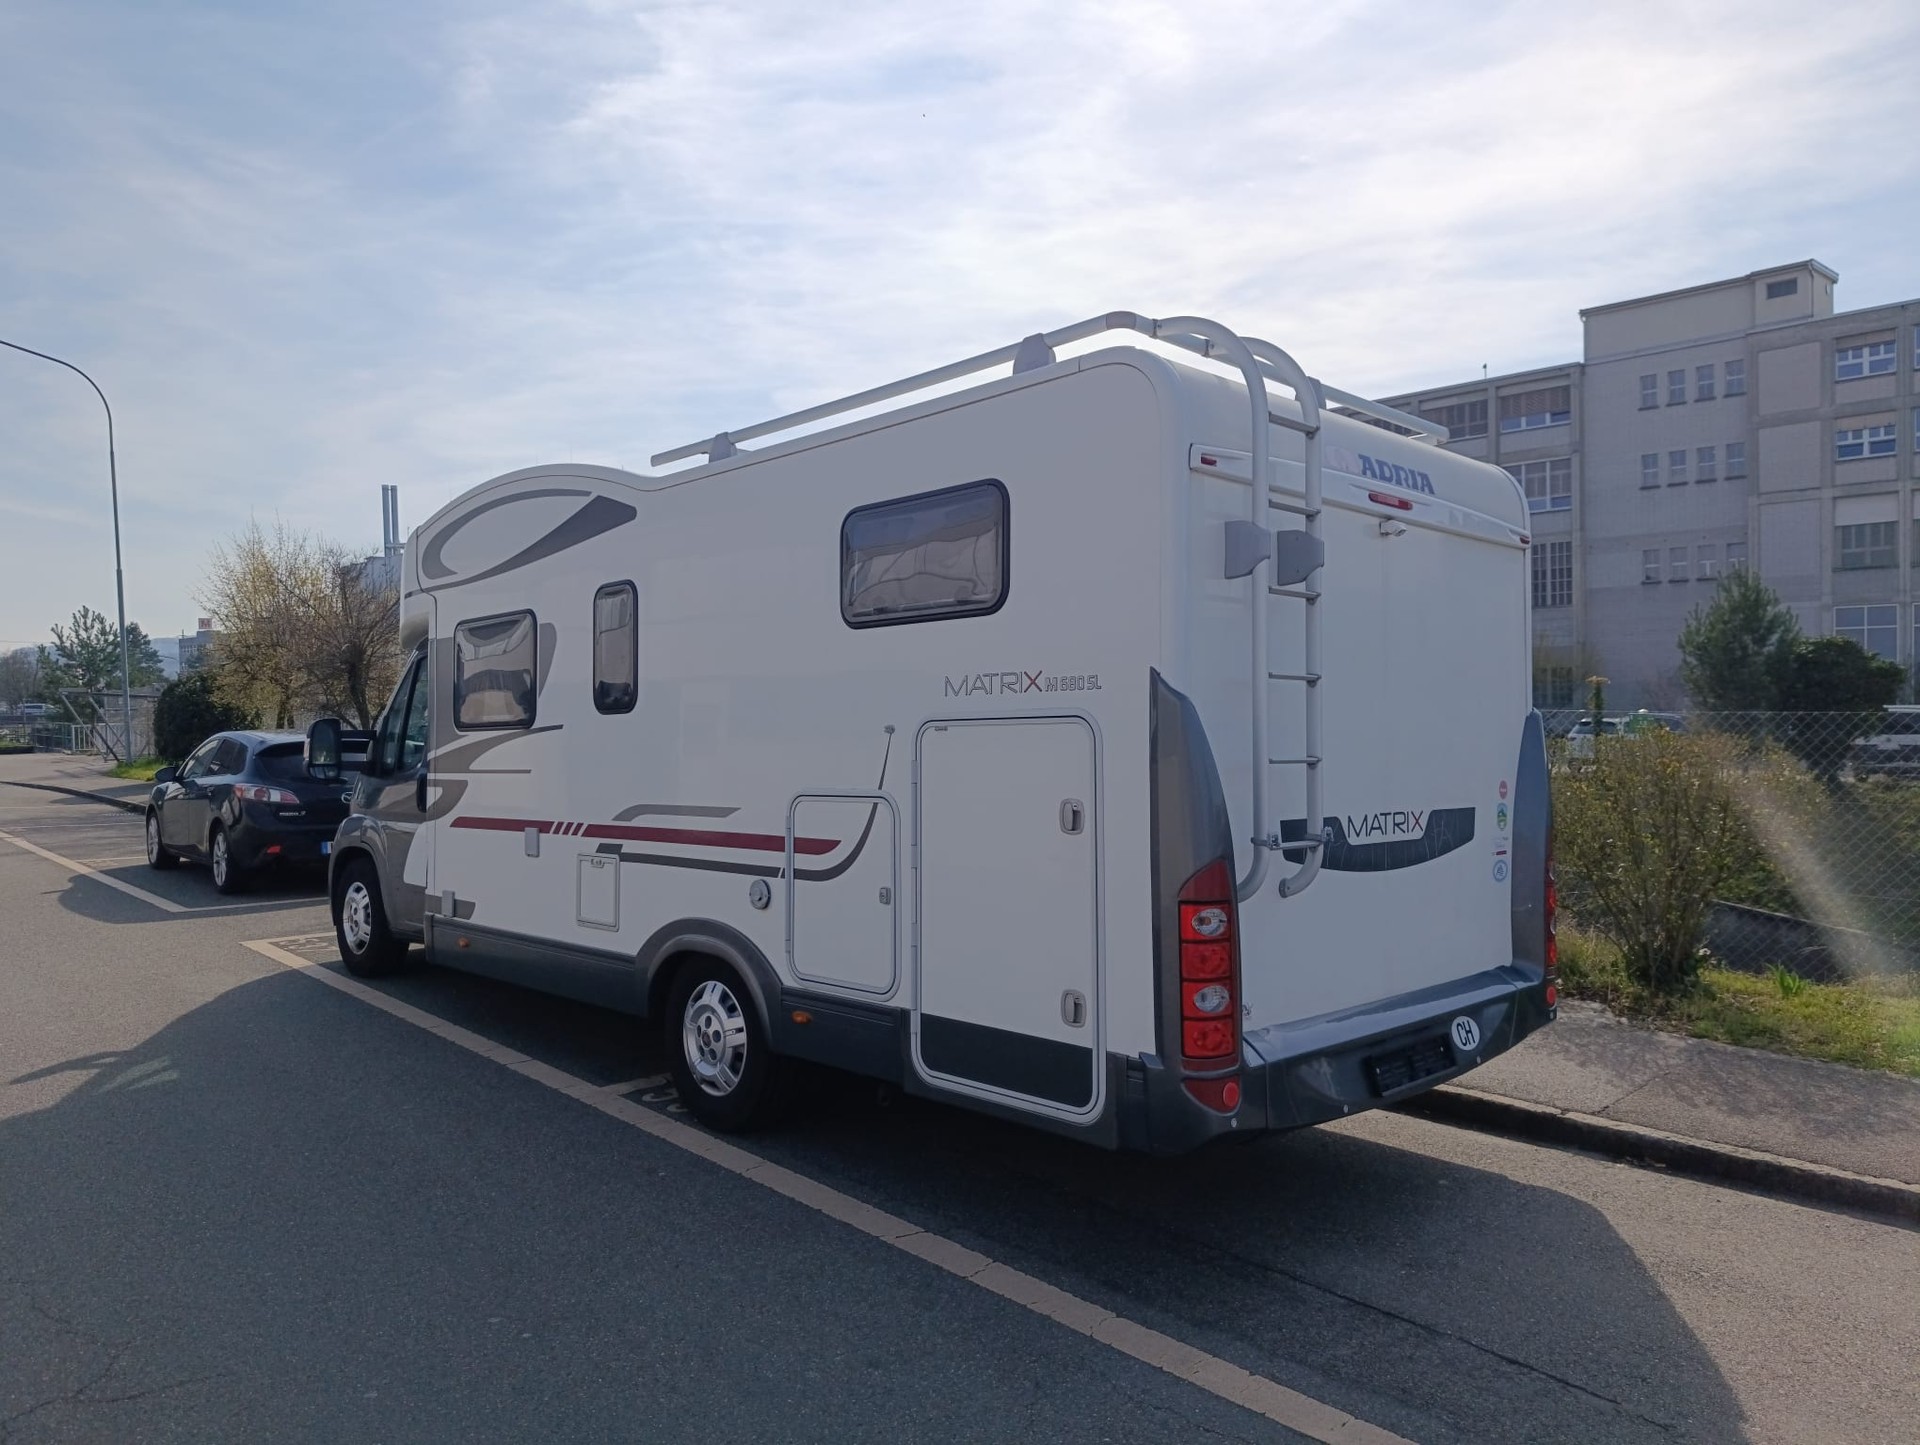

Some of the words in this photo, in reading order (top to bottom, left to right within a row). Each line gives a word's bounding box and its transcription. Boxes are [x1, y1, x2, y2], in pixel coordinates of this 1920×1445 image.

[1358, 453, 1435, 495] ADRIA
[944, 670, 1043, 697] MATRIX
[1347, 810, 1424, 839] MATRIX
[1456, 1019, 1476, 1047] CH
